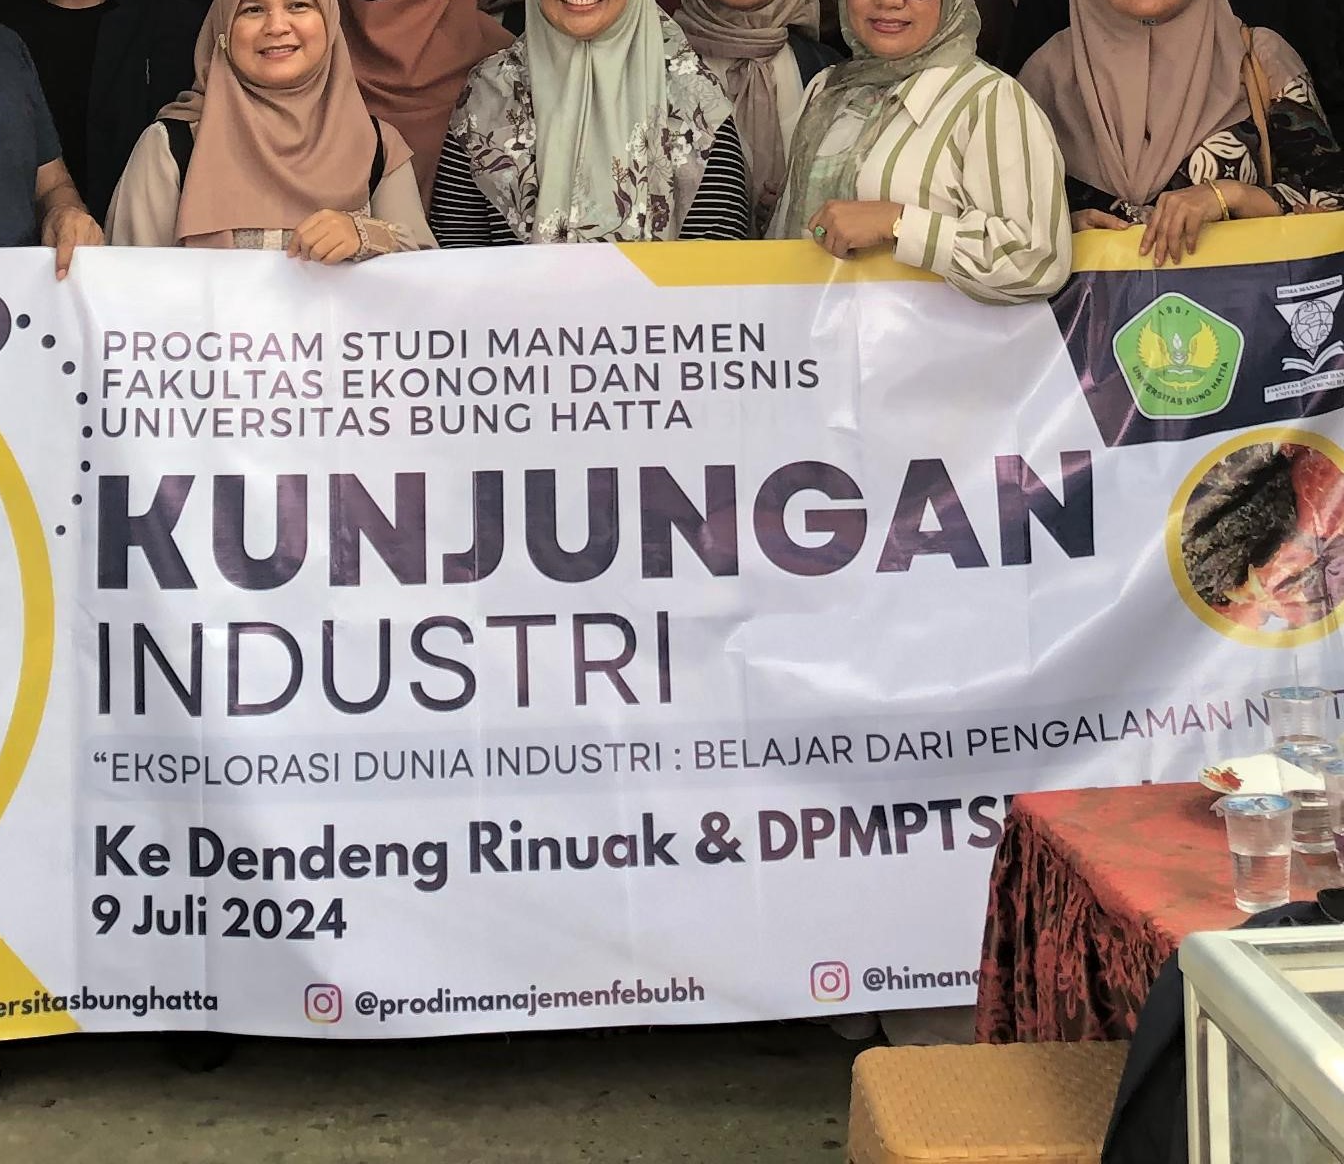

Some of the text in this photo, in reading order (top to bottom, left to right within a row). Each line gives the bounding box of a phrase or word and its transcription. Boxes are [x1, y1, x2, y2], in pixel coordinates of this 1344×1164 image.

[103, 322, 765, 362] PROGRAM STUDI MANAJEMEN
[101, 358, 820, 400] FAKULTAS EKONOMI DAN BISNIS
[101, 399, 692, 438] UNIVERSITAS BUNG HATTA
[97, 449, 1095, 591] KUNJUNGAN
[97, 610, 671, 717] INDUSTRI
[93, 751, 339, 785] “EKSPLORASI
[356, 746, 474, 782] DUNIA
[486, 741, 660, 778] INDUSTRI
[673, 746, 682, 770] :
[695, 735, 853, 770] BELAJAR
[866, 730, 953, 763] DARI
[967, 699, 1232, 757] PENGALAMAN
[94, 794, 1014, 892] Ke Dendeng Rinuak & DPMPTS
[92, 894, 348, 940] 9 Juli 2024
[355, 976, 705, 1022] @prodimanajemenfebubh
